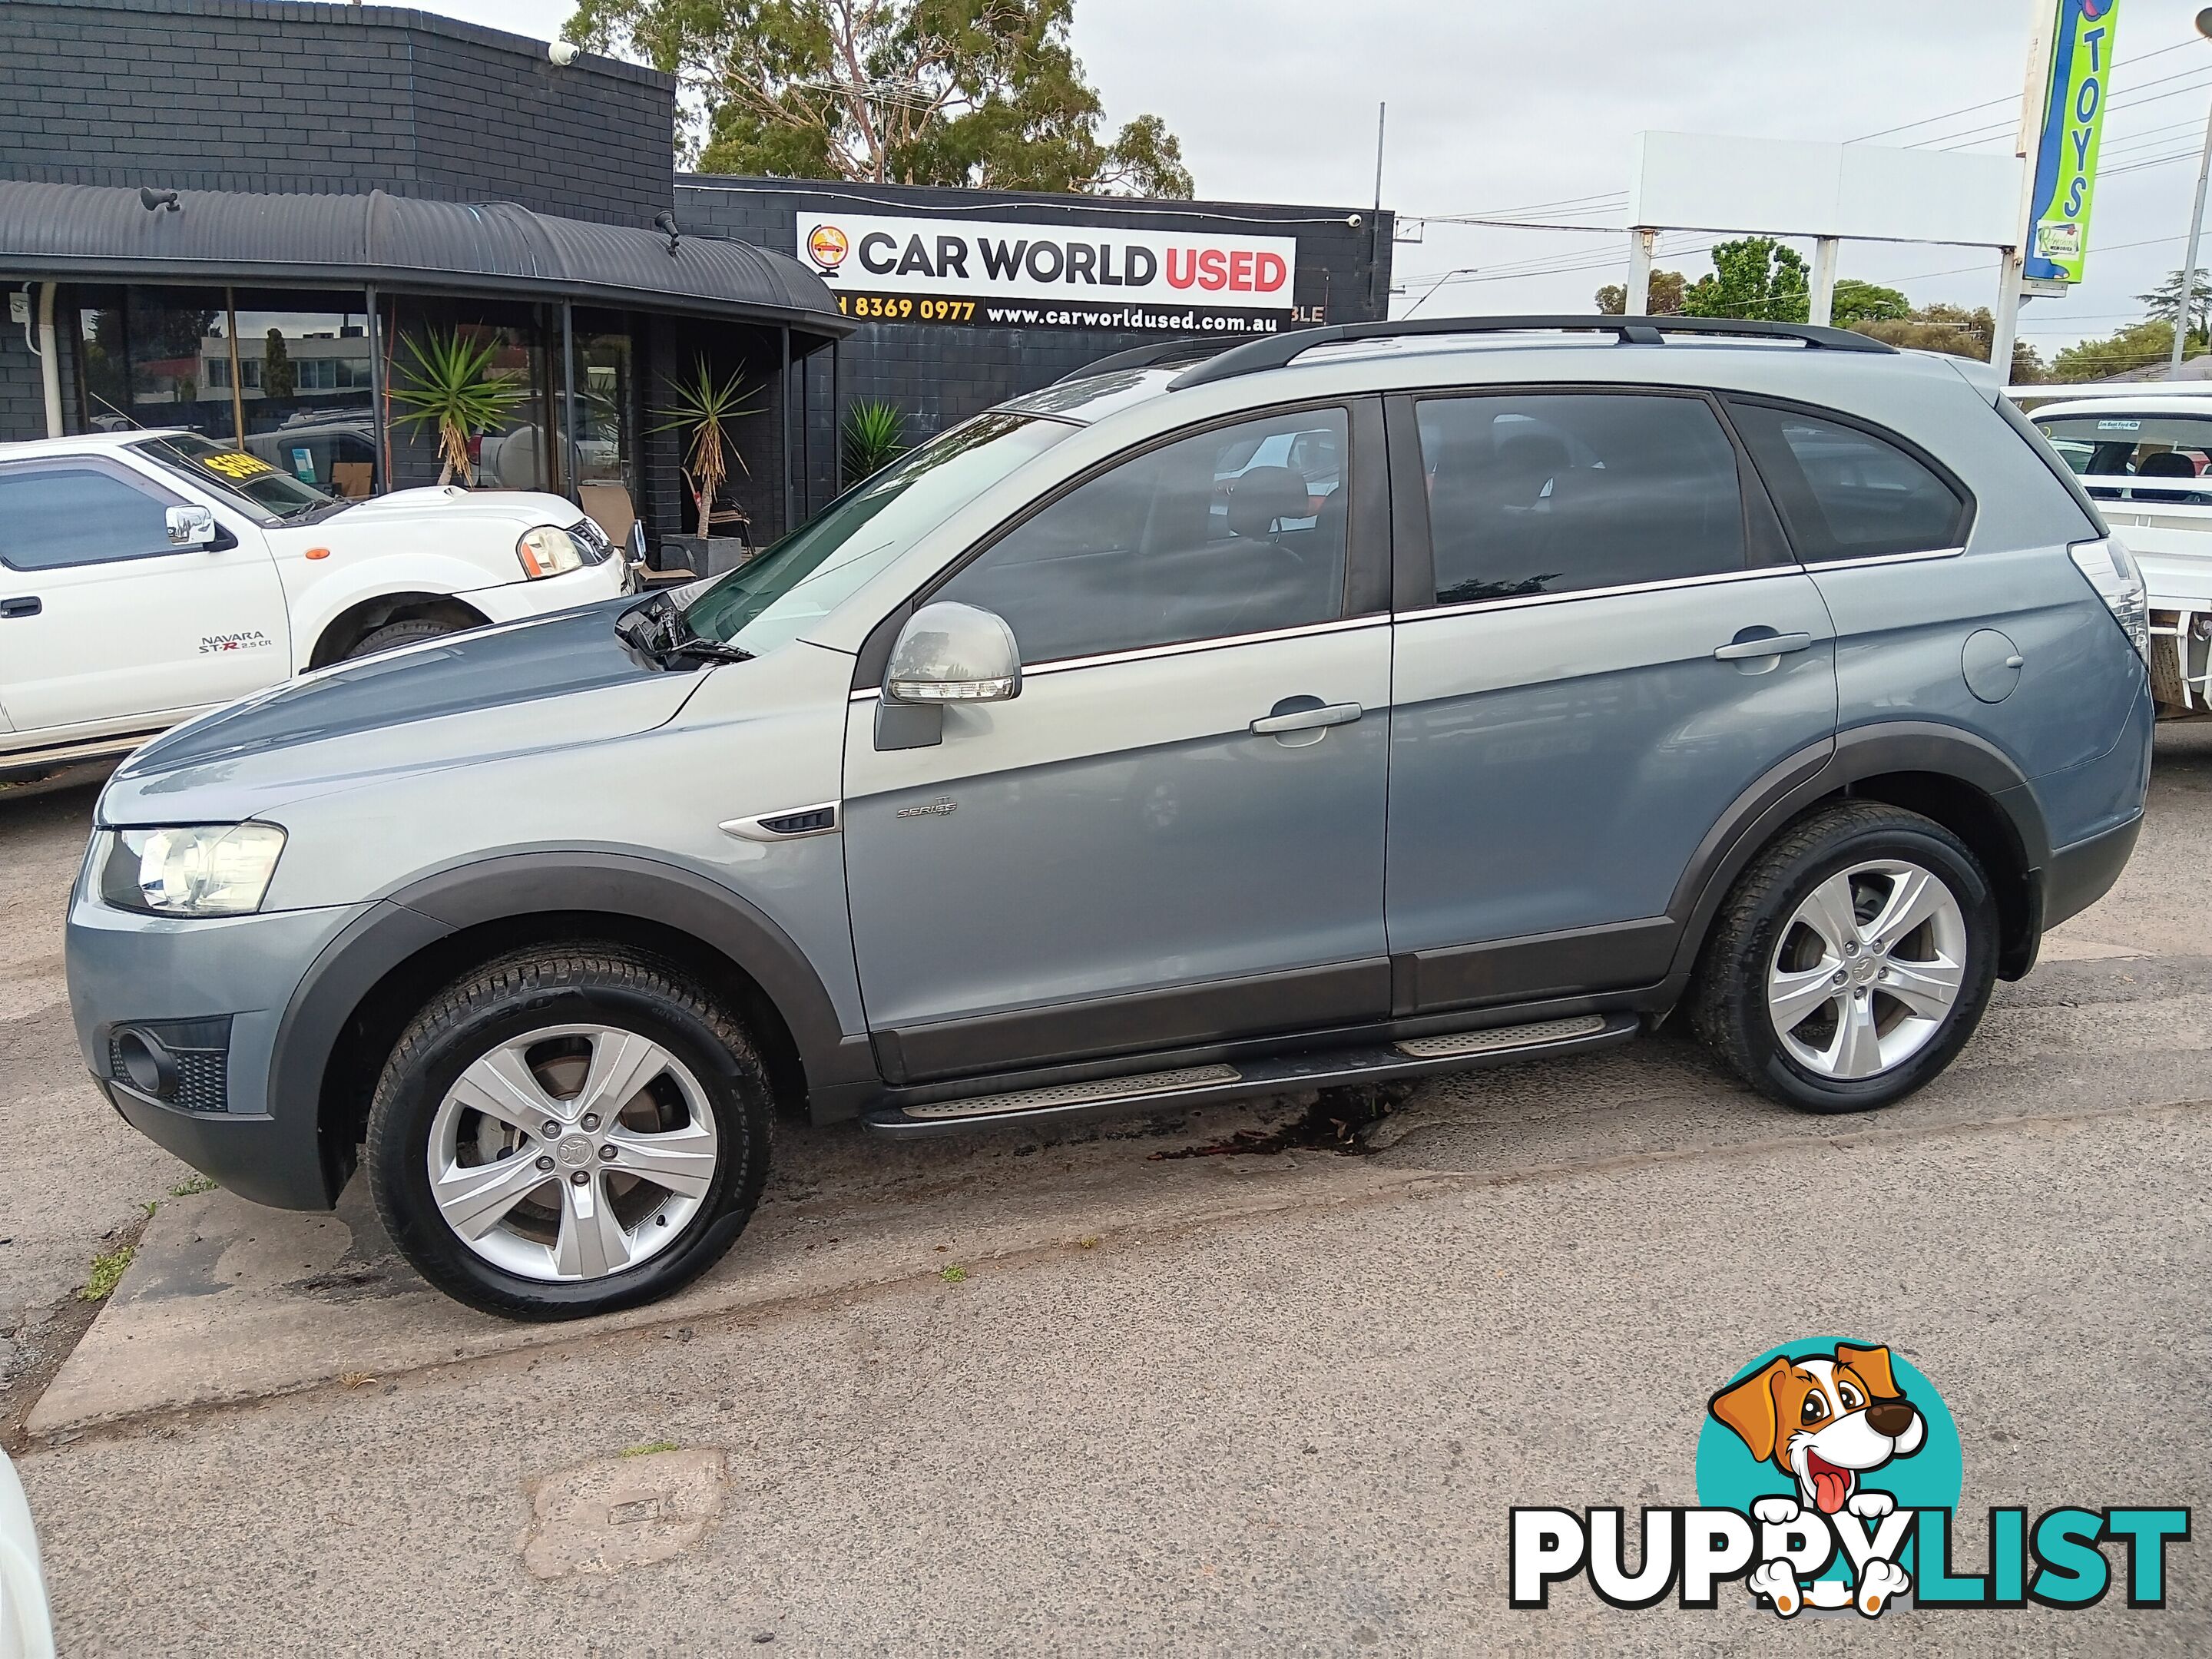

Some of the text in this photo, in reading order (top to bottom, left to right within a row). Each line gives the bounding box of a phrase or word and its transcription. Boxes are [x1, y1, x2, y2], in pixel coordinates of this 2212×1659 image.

[2064, 27, 2105, 218] TOYS
[859, 232, 1286, 292] CAR WORLD USED
[855, 297, 912, 317] 8369
[920, 300, 975, 320] 0977
[986, 308, 1278, 333] www.carworldused.com.au
[199, 642, 240, 654] ST-R
[201, 631, 264, 645] NAVARA
[897, 803, 957, 818] SERIES
